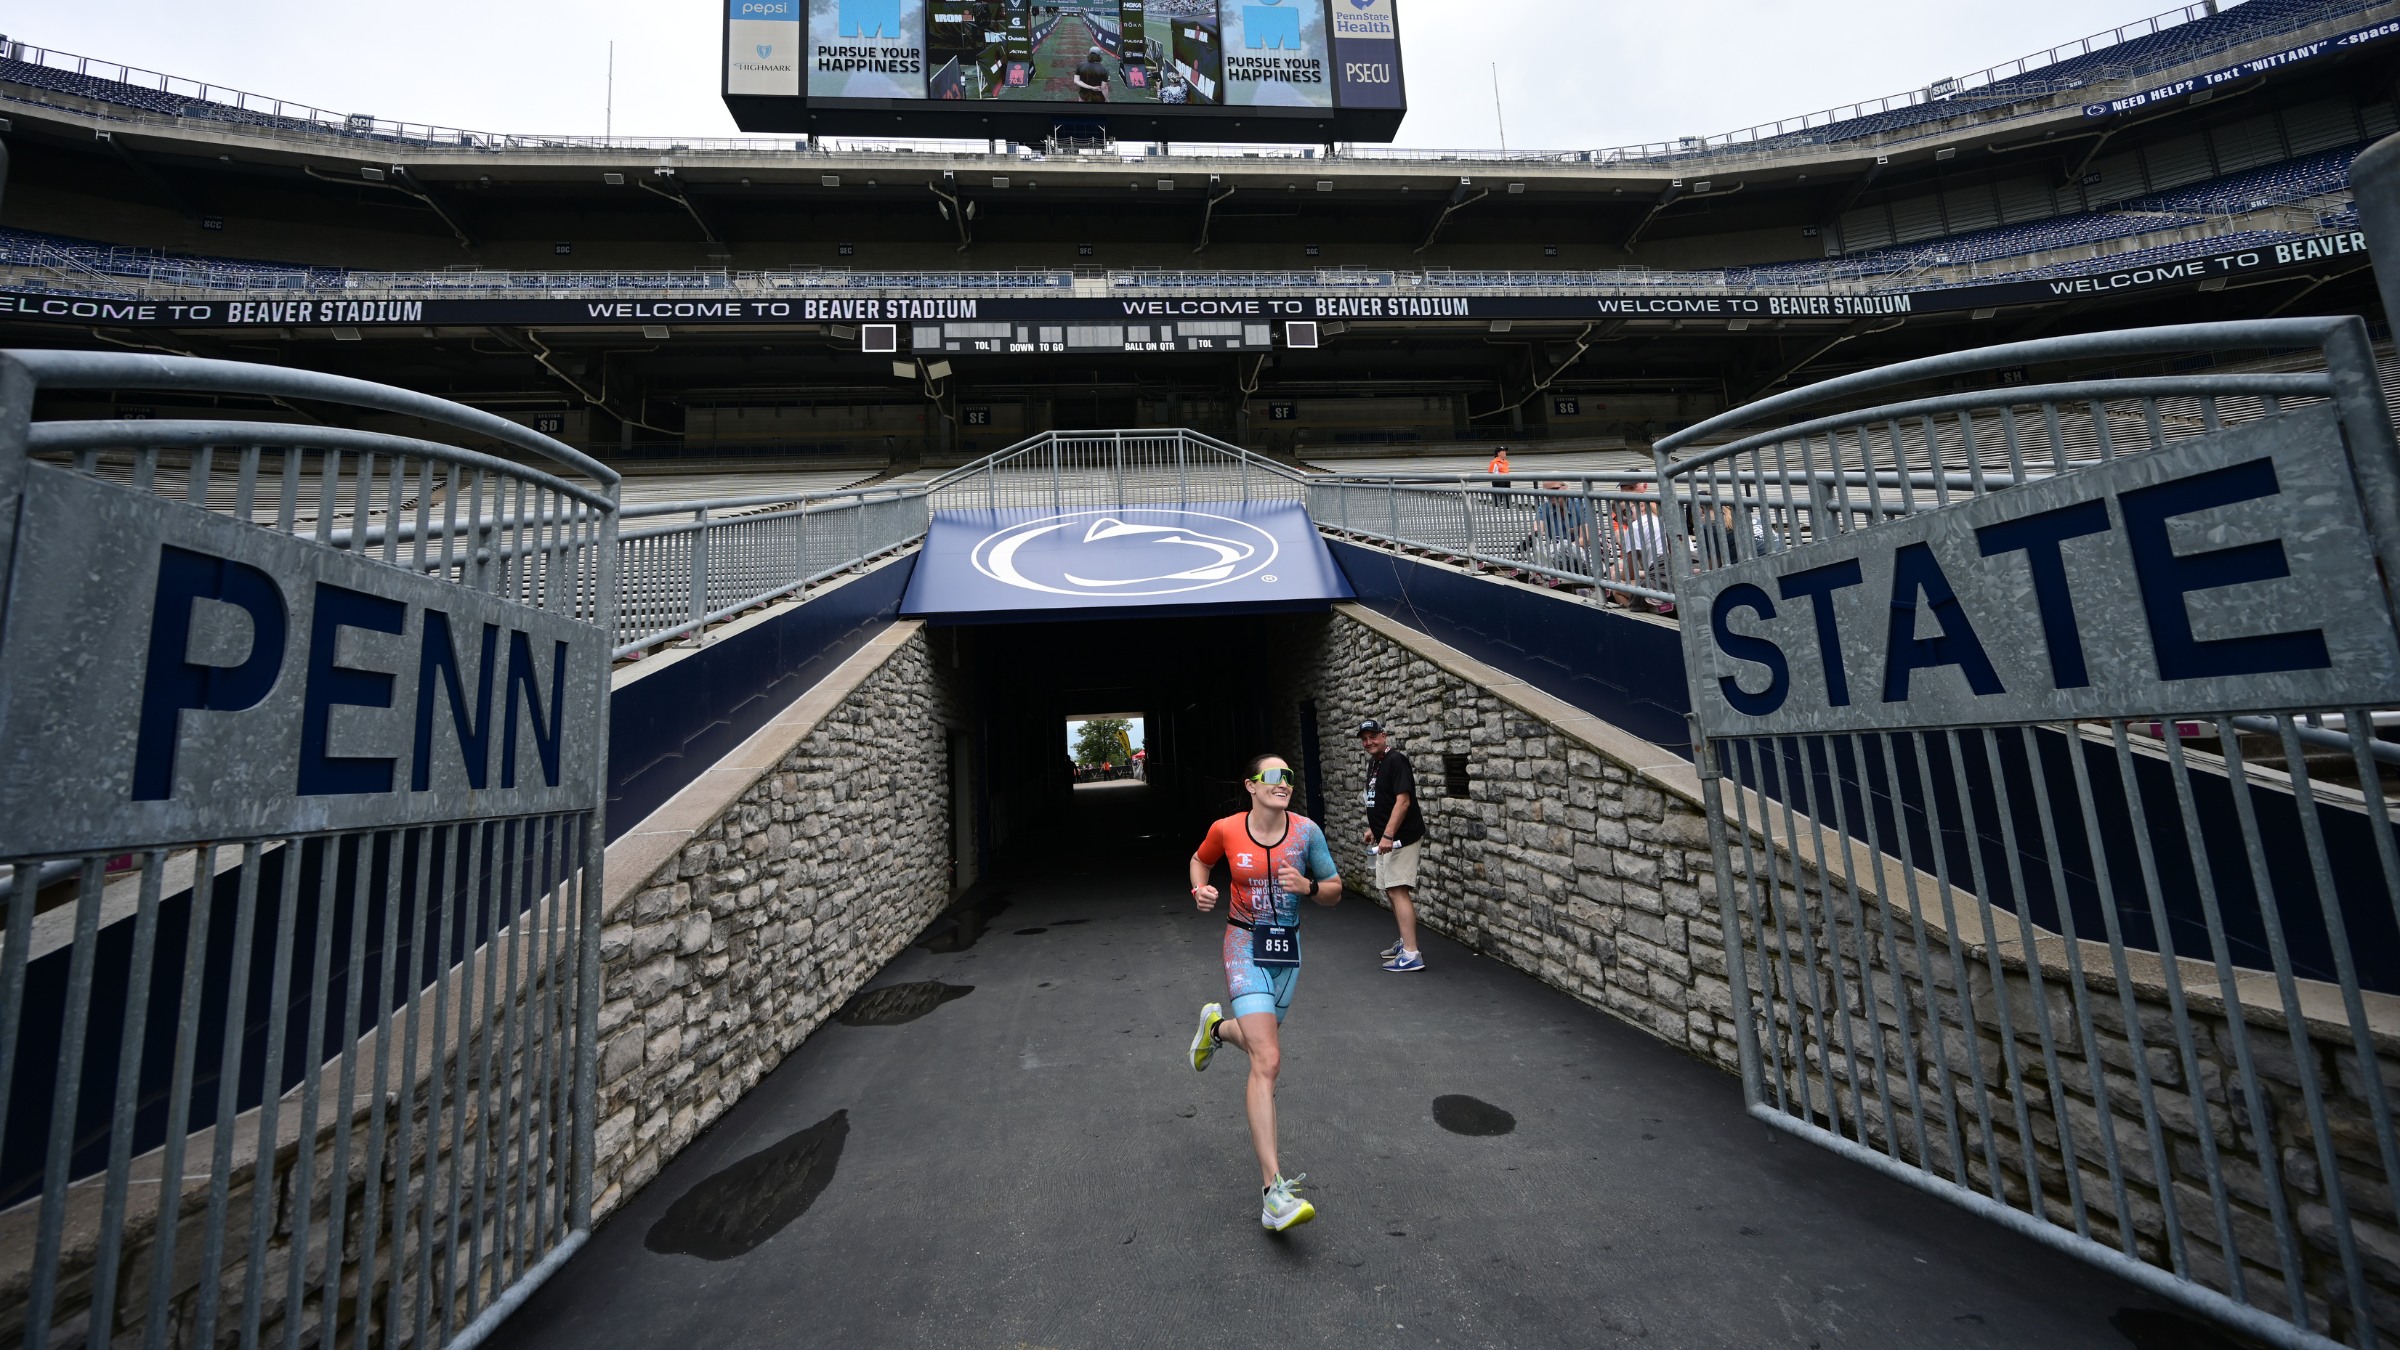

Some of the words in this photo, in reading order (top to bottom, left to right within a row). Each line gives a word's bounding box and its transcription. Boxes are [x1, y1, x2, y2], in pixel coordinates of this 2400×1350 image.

[742, 2, 787, 16] pepsi
[1336, 20, 1391, 34] Health
[819, 46, 877, 58] PURSUE
[880, 48, 921, 59] YOUR
[740, 63, 791, 72] HIGHMARK
[819, 58, 921, 73] HAPPINESS
[1227, 57, 1282, 69] PURSUE
[1284, 59, 1321, 70] YOUR
[1229, 69, 1322, 83] HAPPINESS
[1346, 62, 1390, 83] PSECU
[1933, 81, 1956, 96] SKU
[2112, 94, 2146, 112] NEED
[2150, 80, 2194, 101] HELP?
[2204, 68, 2240, 86] Text
[2083, 174, 2100, 185] SKC
[2250, 198, 2269, 209] SKC
[203, 219, 222, 229] SCC
[1803, 228, 1817, 236] SJC
[1079, 247, 1092, 255] SFC
[2050, 261, 2206, 294] WELCOME
[2214, 252, 2260, 268] TO
[2275, 231, 2367, 264] BEAVER
[588, 303, 742, 317] WELCOME
[751, 302, 790, 317] TO
[804, 300, 880, 319] BEAVER
[886, 300, 977, 319] STADIUM
[1123, 301, 1260, 314] WELCOME
[1268, 301, 1303, 314] TO
[1315, 298, 1383, 316] BEAVER
[1388, 298, 1469, 316] STADIUM
[1598, 299, 1721, 312] WELCOME
[1727, 299, 1759, 312] TO
[1769, 296, 1829, 315] BEAVER
[1834, 294, 1912, 314] STADIUM
[168, 305, 212, 320] TO
[227, 301, 312, 322] BEAVER
[319, 301, 422, 321] STADIUM
[975, 340, 990, 350] TOL
[1009, 342, 1034, 352] DOWN
[1039, 342, 1050, 352] TO
[1052, 342, 1064, 352] GO
[1125, 342, 1144, 351] BALL
[1146, 342, 1158, 351] ON
[1160, 342, 1175, 351] QTR
[1198, 339, 1213, 348] TOL
[1275, 407, 1289, 418] SF
[1560, 402, 1575, 414] SG
[969, 412, 985, 424] SE
[540, 419, 558, 431] SD
[1710, 455, 2332, 717] STATE
[131, 543, 569, 801] PENN
[1265, 938, 1290, 953] 855
